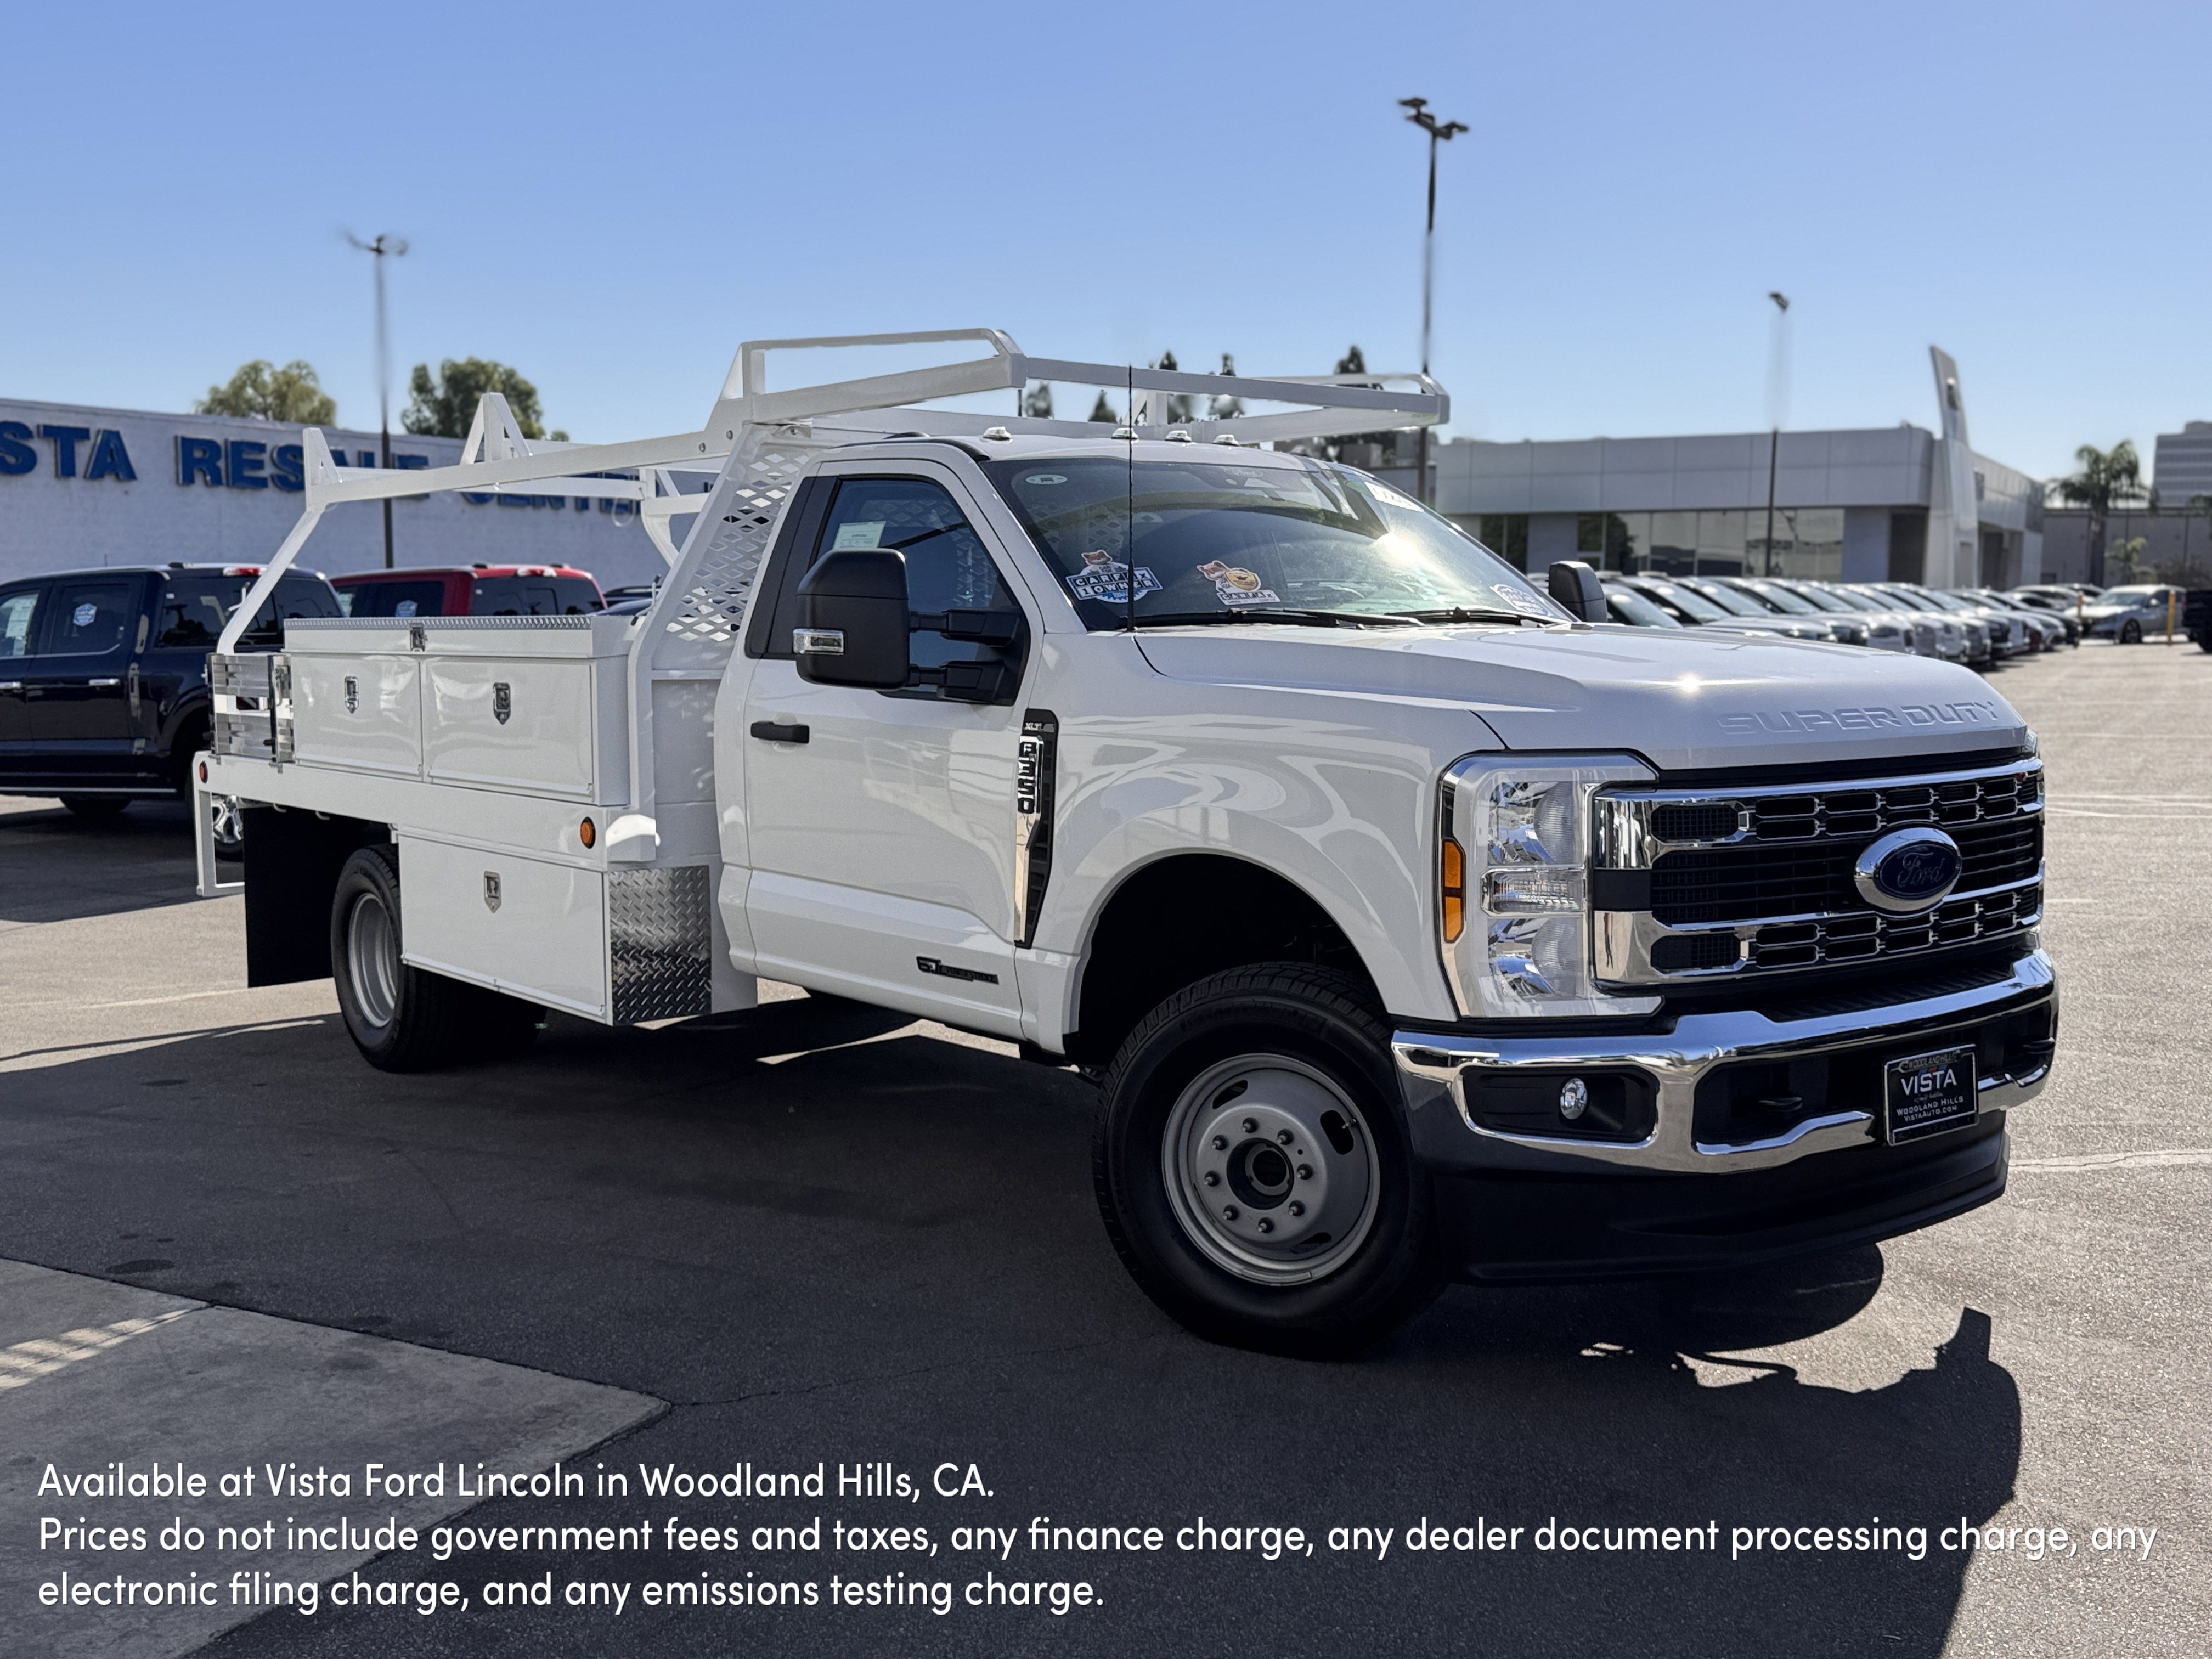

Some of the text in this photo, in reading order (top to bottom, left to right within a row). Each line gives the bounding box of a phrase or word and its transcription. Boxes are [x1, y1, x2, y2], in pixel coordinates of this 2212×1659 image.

[1093, 580, 1154, 593] OWNER
[1717, 701, 1998, 735] SUPER DUTY
[1897, 851, 1946, 888] Ford
[1900, 1068, 1957, 1096] VISTA
[1896, 1102, 1938, 1116] WOODLAND
[1940, 1095, 1964, 1106] HILLS
